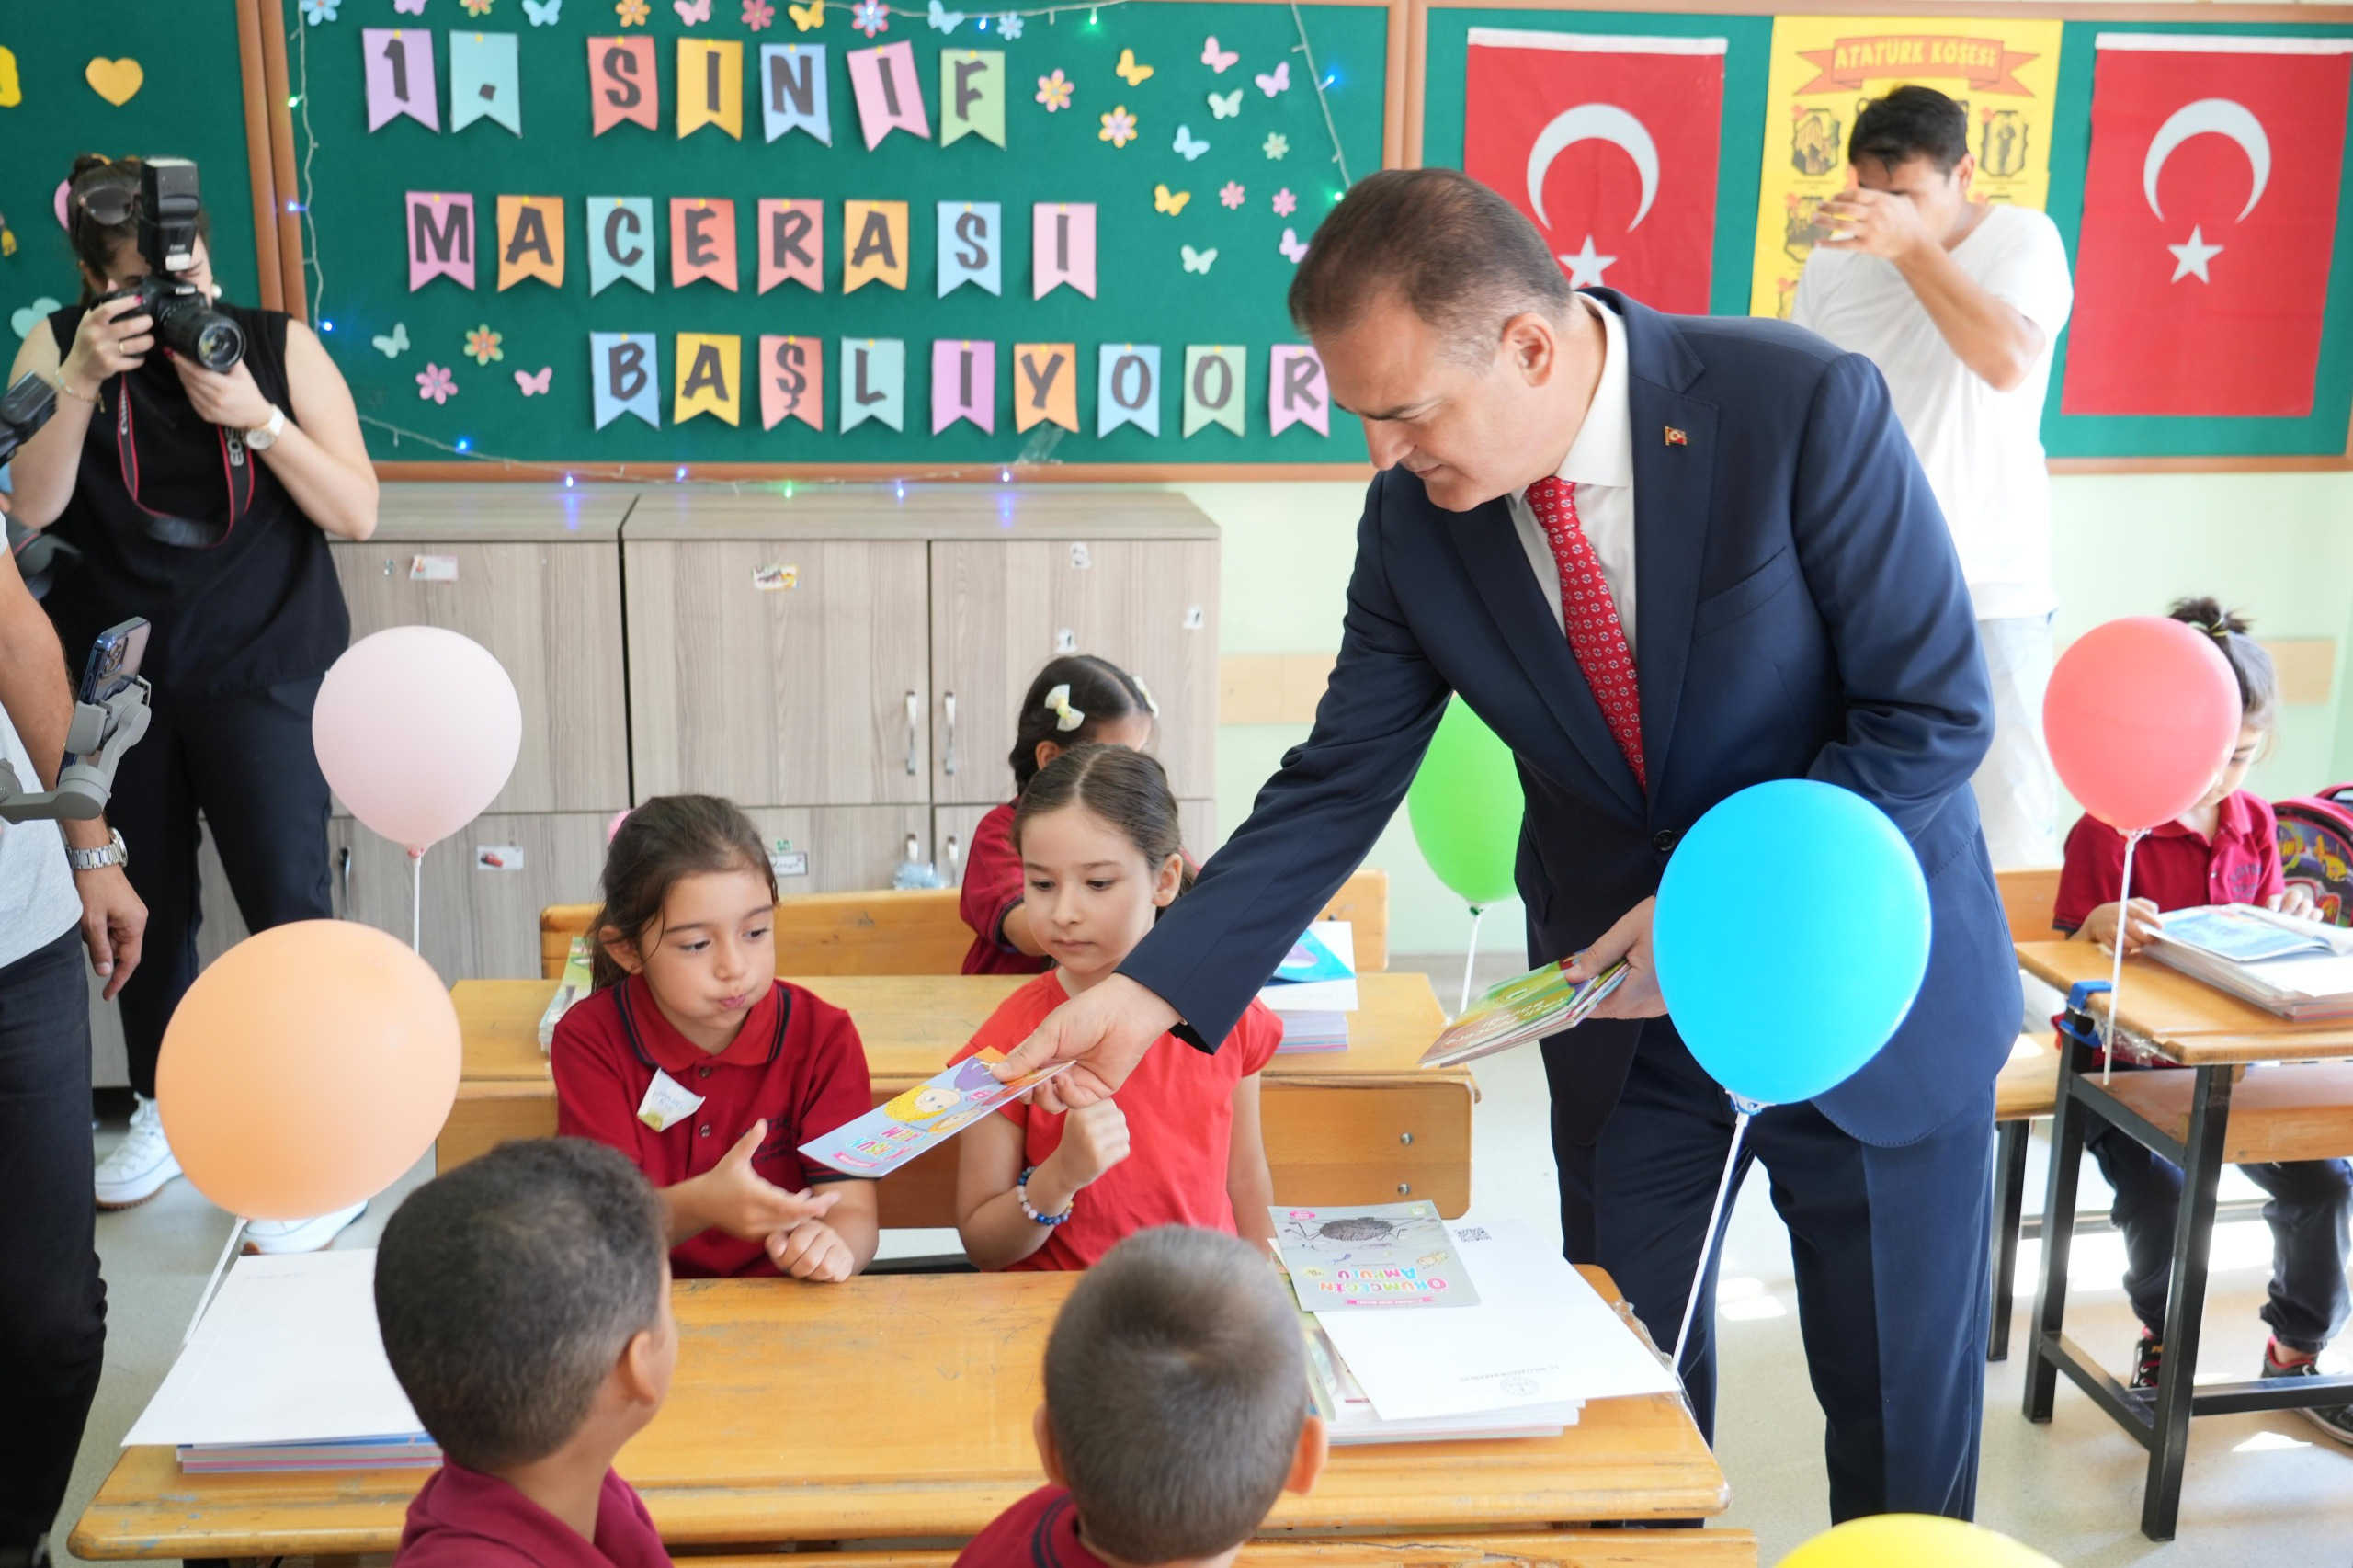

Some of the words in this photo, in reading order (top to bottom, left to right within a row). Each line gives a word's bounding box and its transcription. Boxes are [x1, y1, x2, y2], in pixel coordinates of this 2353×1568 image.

[602, 47, 989, 122] SINIF
[413, 201, 1070, 271] MACERASI
[608, 342, 1322, 411] BAŞLIYOOR
